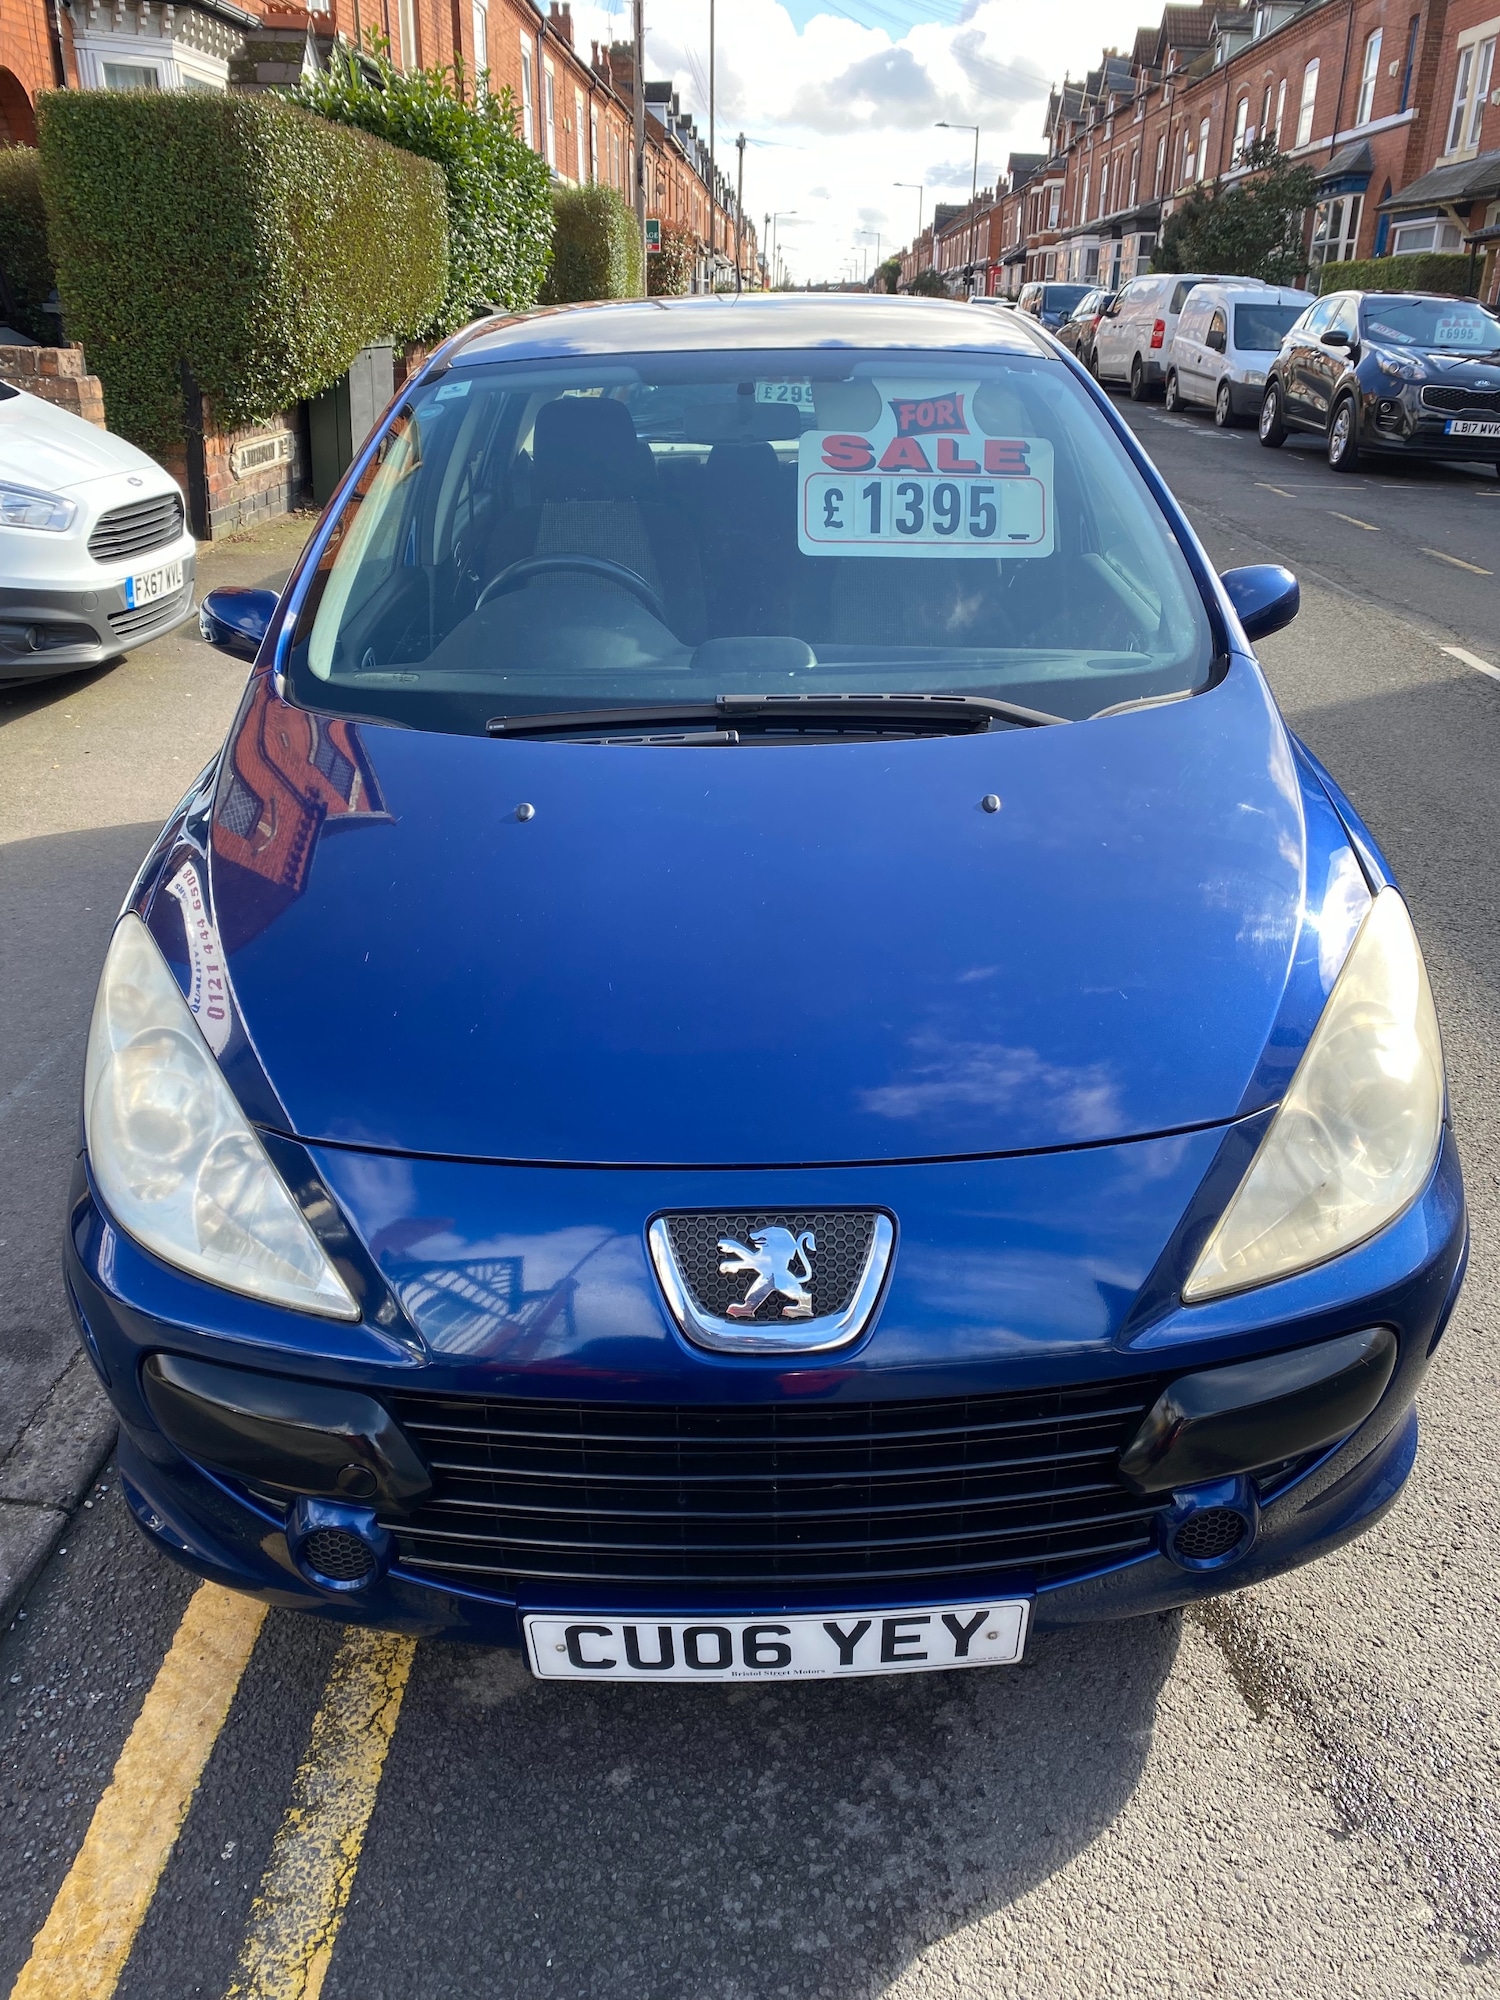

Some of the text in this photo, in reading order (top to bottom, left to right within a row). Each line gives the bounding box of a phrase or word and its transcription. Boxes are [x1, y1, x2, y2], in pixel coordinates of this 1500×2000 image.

[1442, 319, 1481, 328] SALE
[900, 399, 957, 430] FOR
[1454, 422, 1500, 434] LB17 MVK
[821, 434, 1031, 476] SALE
[135, 563, 182, 601] FX67 WVL
[182, 868, 202, 911] 6508
[196, 918, 214, 955] 444
[206, 964, 226, 1021] 0121
[564, 1610, 991, 1671] CU06 YEY
